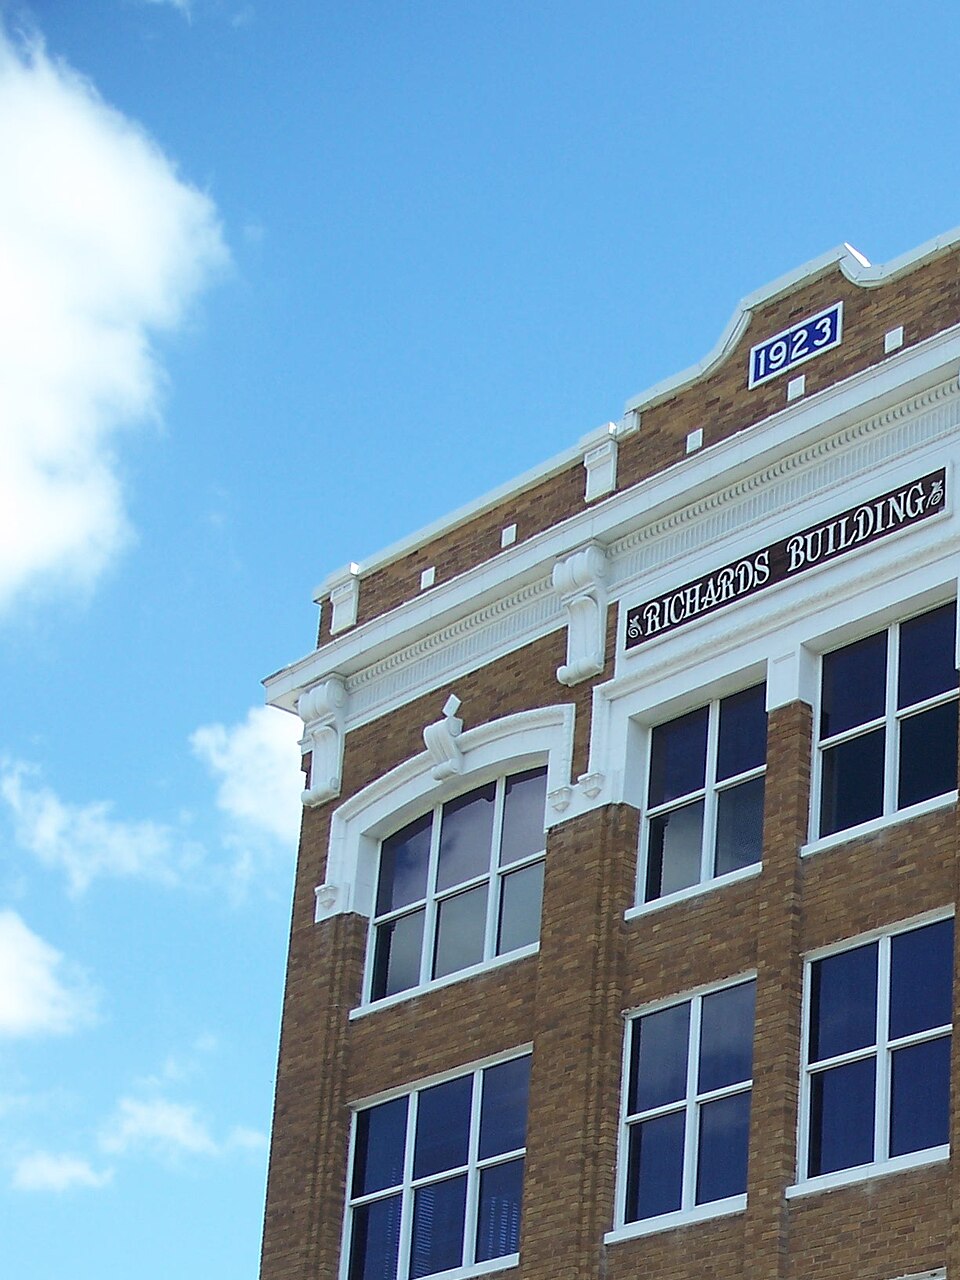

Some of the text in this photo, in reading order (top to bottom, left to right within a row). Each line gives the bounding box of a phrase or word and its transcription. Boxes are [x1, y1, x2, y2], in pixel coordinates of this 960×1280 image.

[757, 317, 832, 377] 1923
[642, 482, 925, 637] RICHARDS BUILDING
